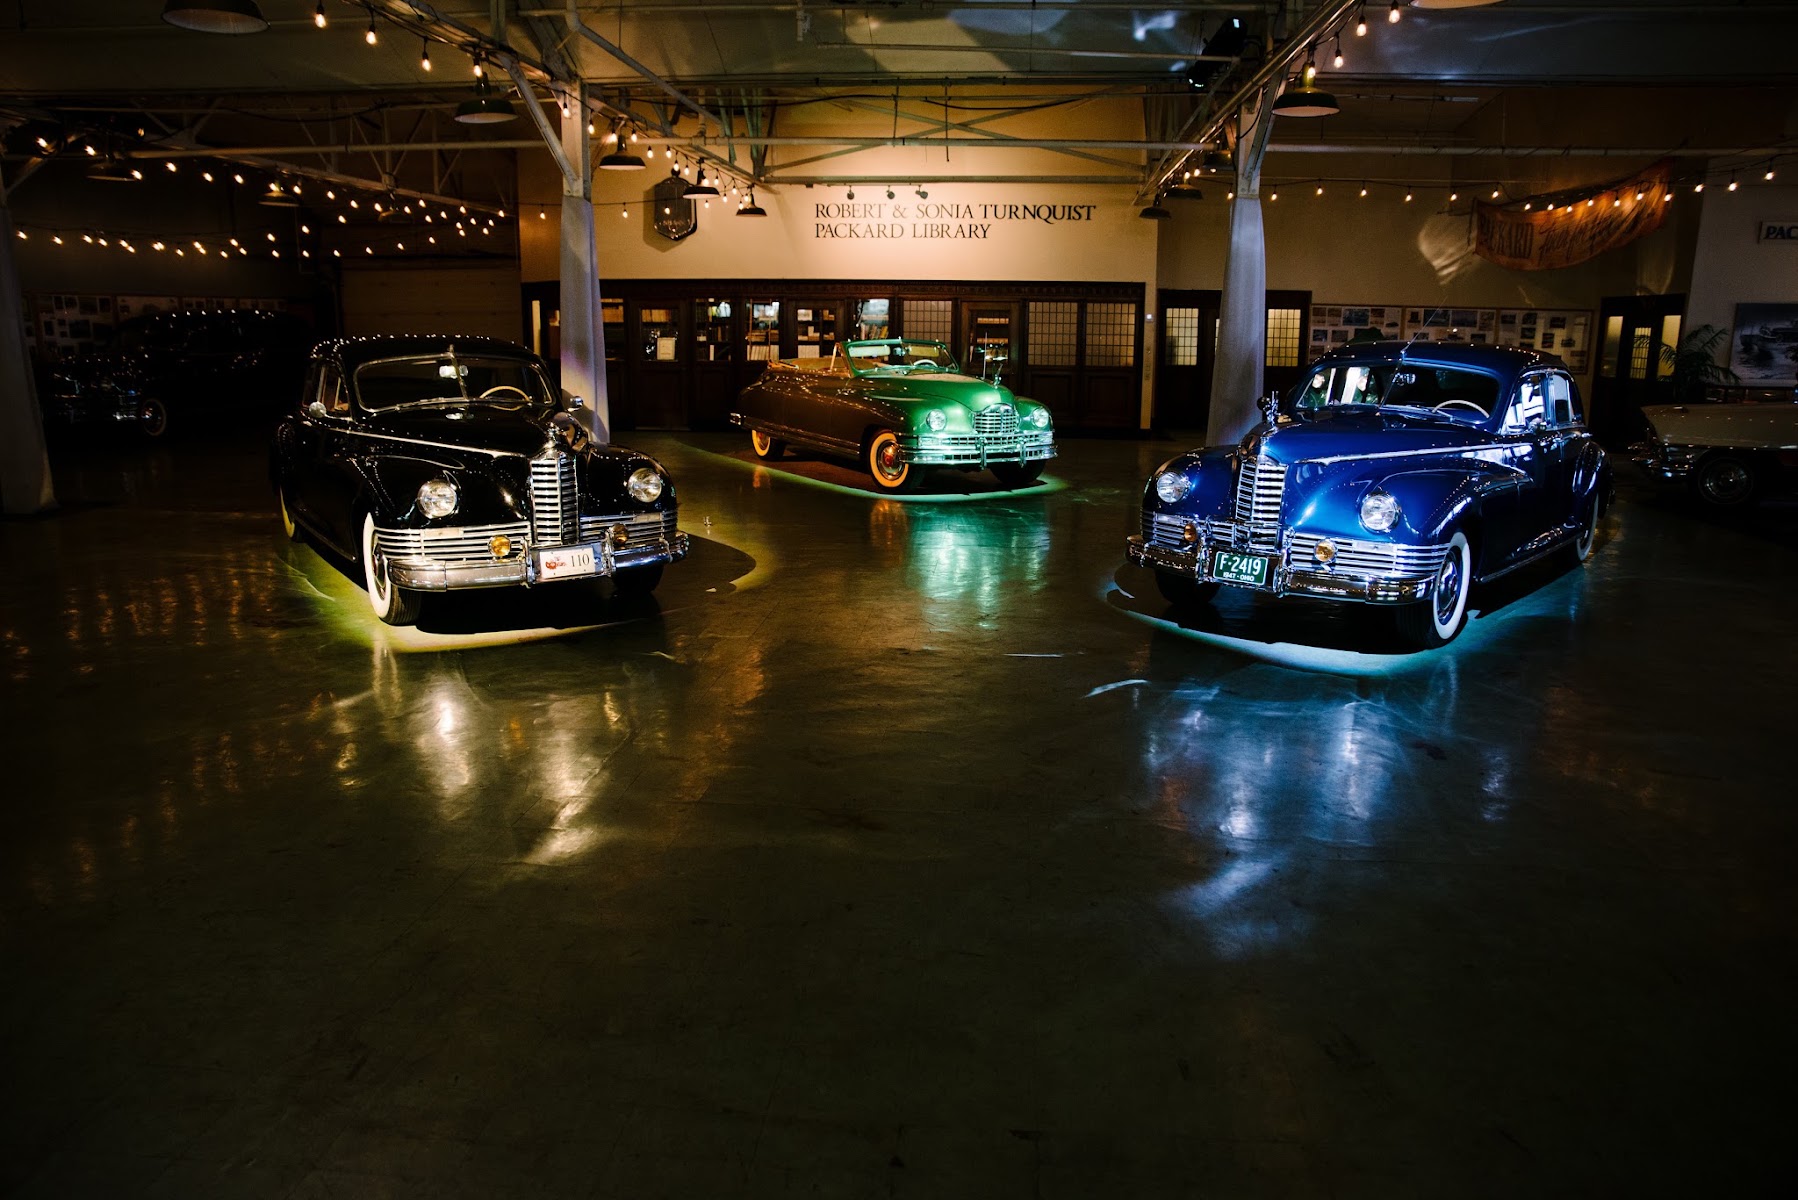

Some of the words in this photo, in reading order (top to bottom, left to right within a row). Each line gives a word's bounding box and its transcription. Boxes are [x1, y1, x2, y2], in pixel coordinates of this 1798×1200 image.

[815, 203, 886, 219] ROBERT
[892, 204, 907, 219] &
[916, 203, 974, 219] SONIA
[978, 204, 1096, 224] TURNQUIST
[815, 223, 905, 239] PACKARD
[912, 223, 991, 239] LIBRARY
[571, 554, 590, 567] 110
